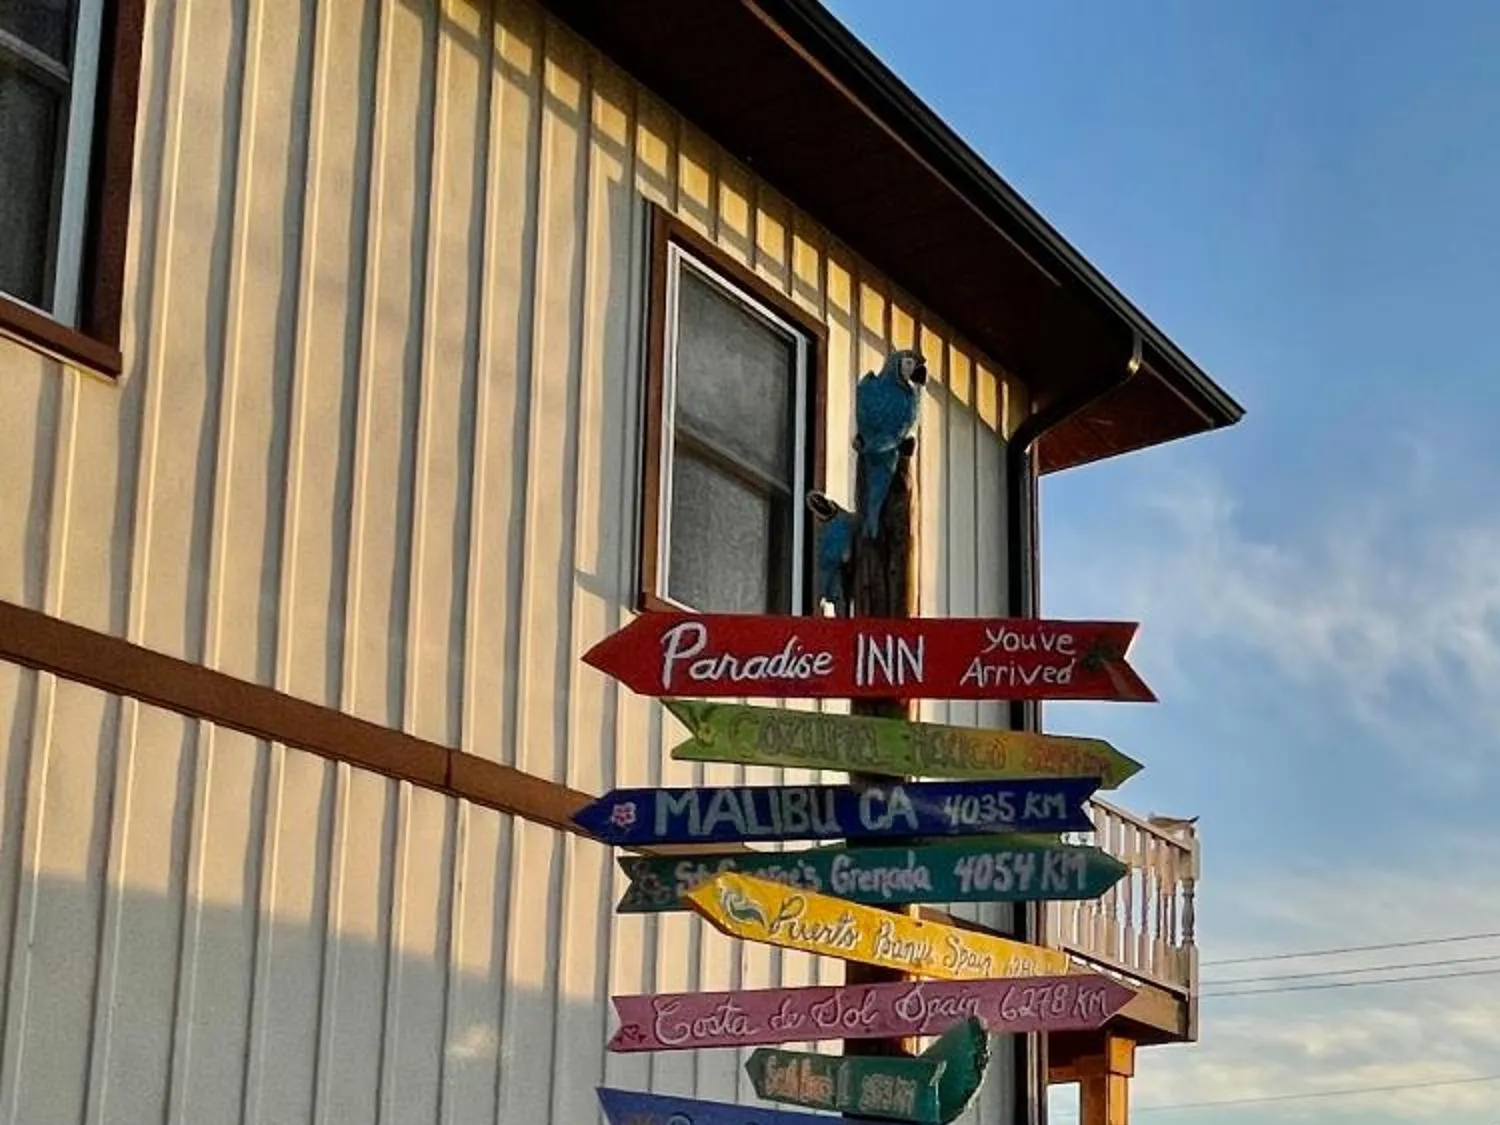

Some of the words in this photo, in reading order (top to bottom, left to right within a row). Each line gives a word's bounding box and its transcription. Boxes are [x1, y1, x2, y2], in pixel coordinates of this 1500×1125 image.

[659, 620, 834, 690] Paradise
[855, 632, 925, 686] INN
[959, 656, 1078, 688] Arrived
[654, 787, 843, 837] MALIBU
[859, 785, 919, 831] CA
[943, 792, 1017, 826] 4035
[1020, 790, 1068, 820] KM
[832, 850, 933, 898] Grenada
[953, 852, 1035, 894] 4054
[1040, 850, 1088, 893] KM
[942, 932, 993, 977] Spain
[652, 996, 759, 1046] Costa
[810, 985, 879, 1030] Sol
[894, 981, 981, 1033] Spain
[1001, 983, 1070, 1022] 6278
